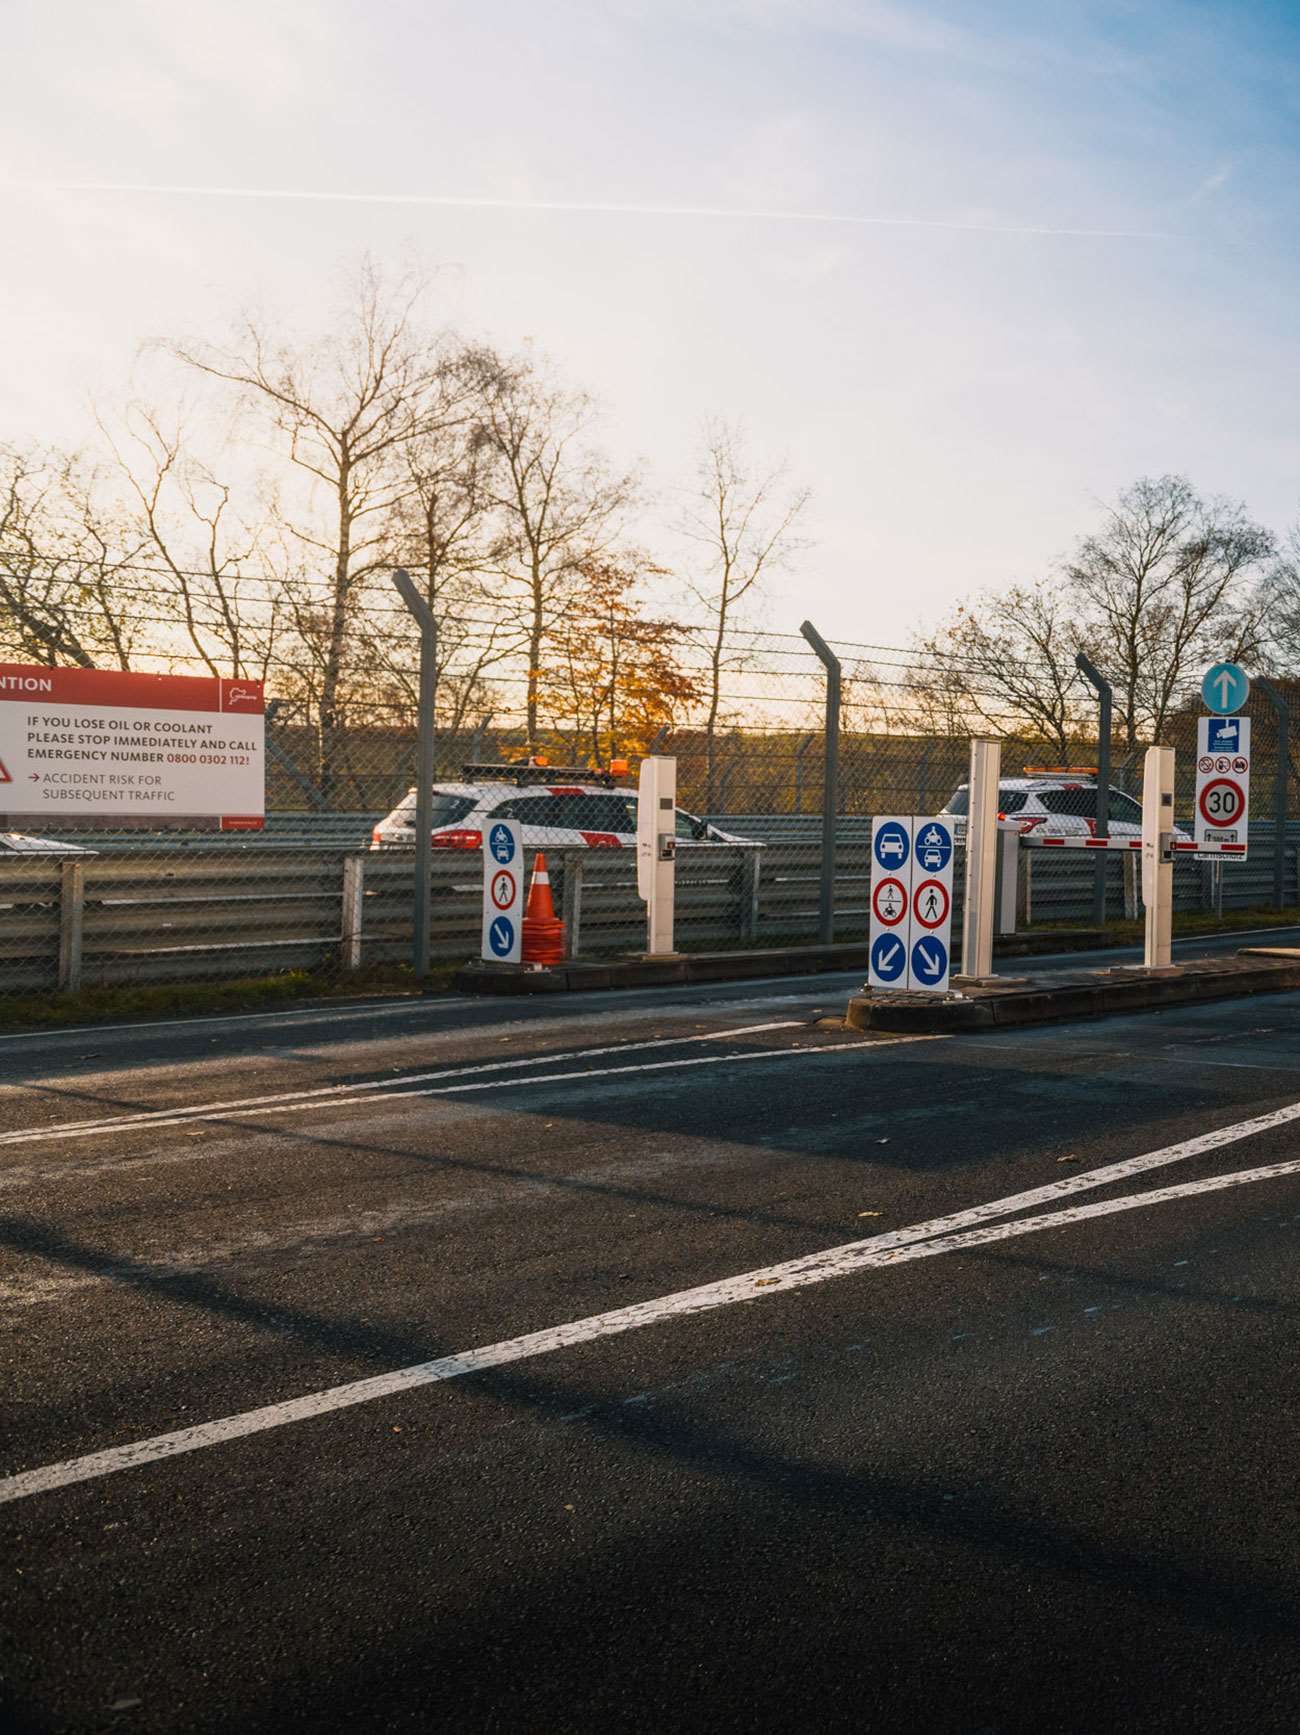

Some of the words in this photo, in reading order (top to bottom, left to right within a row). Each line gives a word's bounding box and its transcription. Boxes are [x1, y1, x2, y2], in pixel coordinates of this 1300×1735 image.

[27, 716, 39, 726] IF
[42, 717, 71, 727] YOU
[74, 718, 105, 729] LOSE
[108, 720, 130, 730] OIL
[133, 721, 151, 731] OR
[154, 722, 213, 733] COOLANT
[27, 732, 75, 744] PLEASE
[78, 734, 111, 745] STOP
[114, 736, 197, 748] IMMEDIATELY
[200, 740, 226, 750] AND
[229, 740, 257, 751] CALL
[27, 748, 107, 760] EMERGENCY
[111, 752, 164, 762] NUMBER
[167, 753, 197, 763] 0800
[199, 754, 227, 765] 0302
[230, 755, 250, 765] 112!
[43, 773, 106, 784] ACCIDENT
[109, 774, 135, 785] RISK
[138, 775, 162, 786] FOR
[42, 788, 124, 802] SUBSEQUENT
[128, 790, 176, 801] TRAFFIC
[1209, 791, 1236, 814] 30
